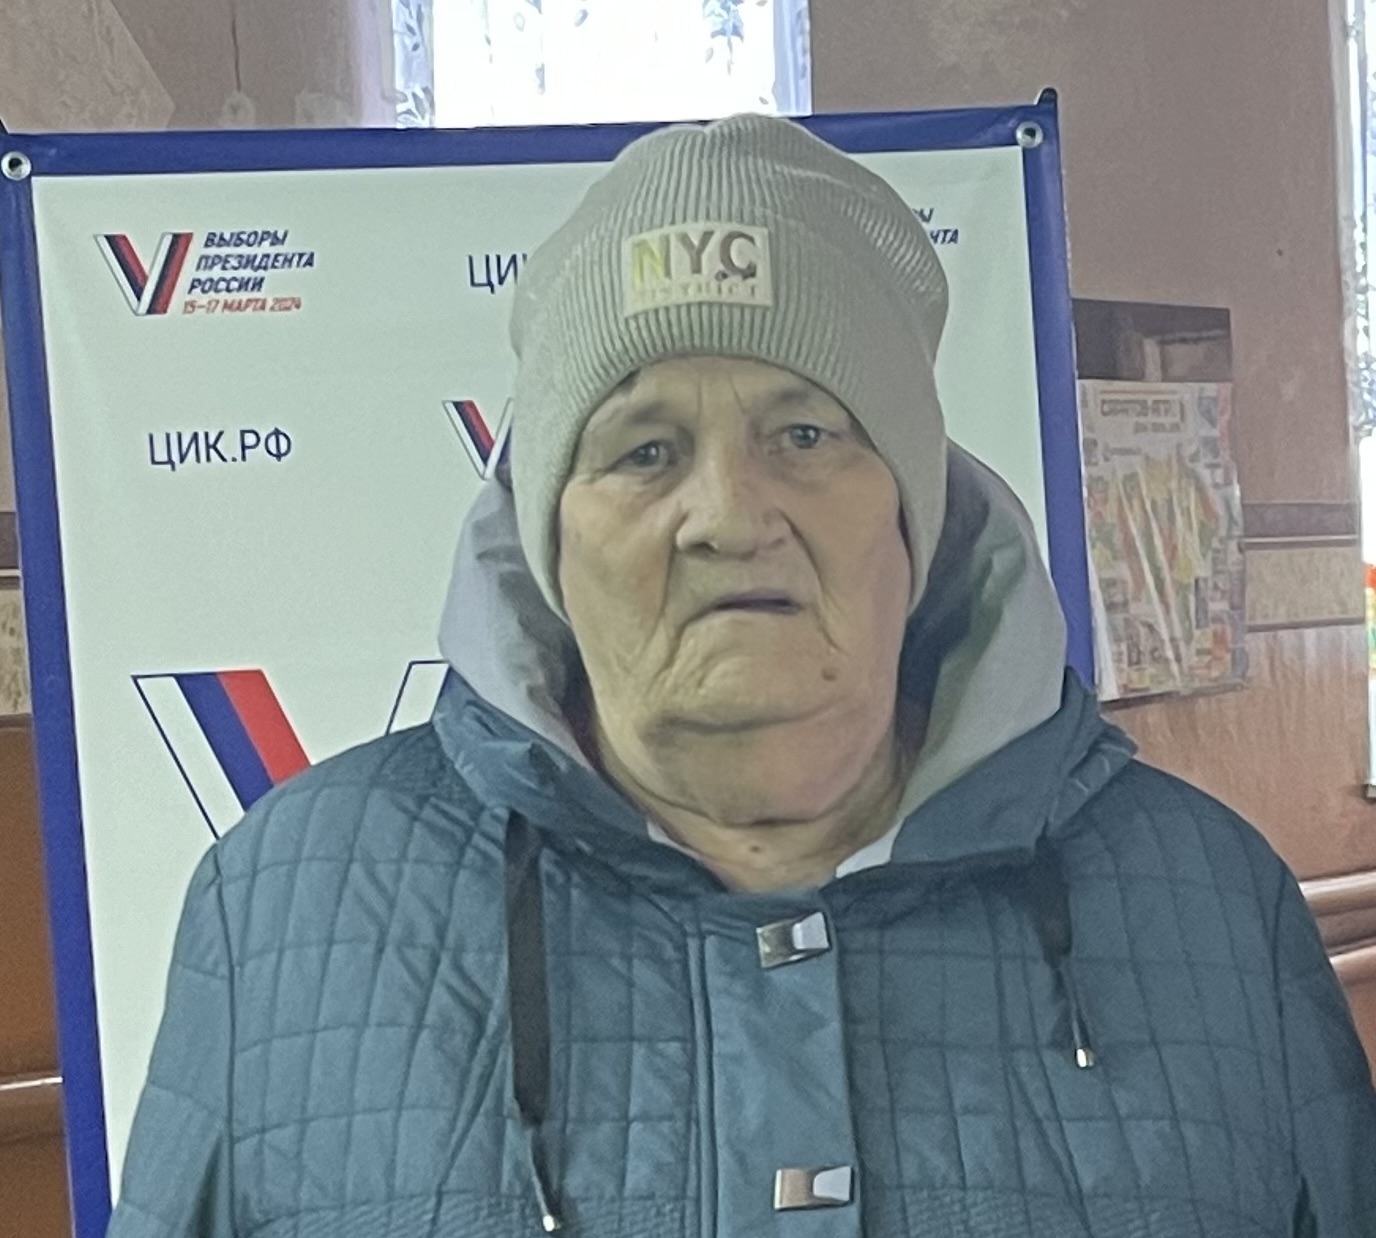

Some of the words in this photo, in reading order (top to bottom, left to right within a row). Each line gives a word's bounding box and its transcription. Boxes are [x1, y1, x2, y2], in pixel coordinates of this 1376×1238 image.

[203, 230, 288, 248] ВЫБОРЫ
[196, 251, 315, 272] ПРЕЗИДЕНТА
[187, 276, 265, 295] РОССИИ
[221, 298, 267, 313] МАРТА
[148, 427, 292, 472] ЦИК.РФ
